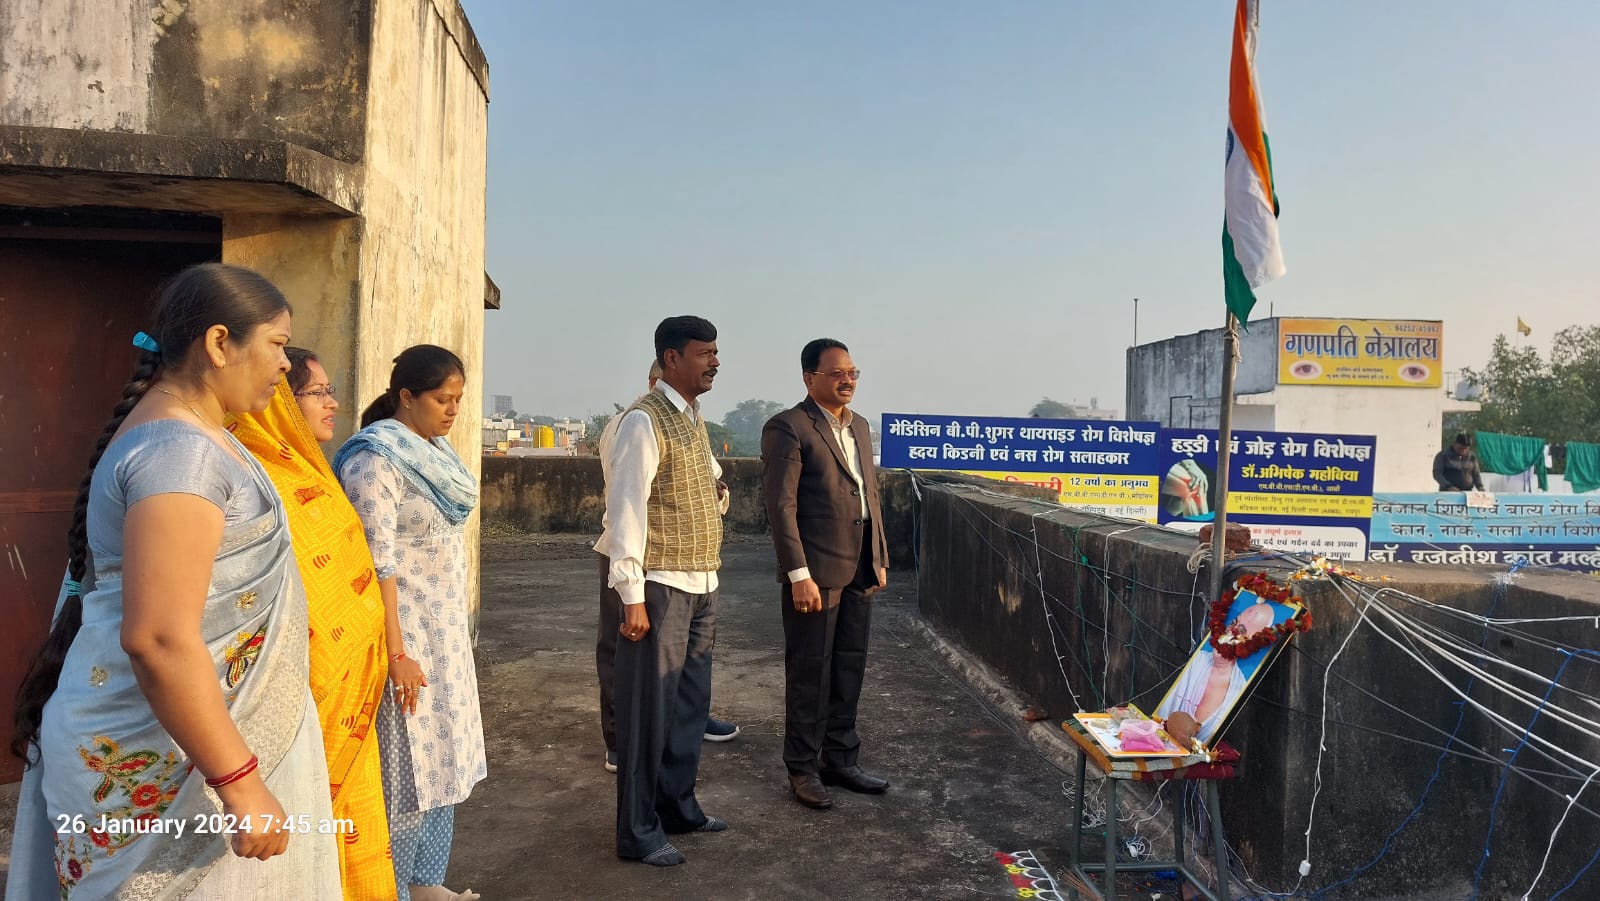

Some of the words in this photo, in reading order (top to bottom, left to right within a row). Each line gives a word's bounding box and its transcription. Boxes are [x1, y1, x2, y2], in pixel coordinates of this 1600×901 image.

[1285, 325, 1358, 357] गणपति
[1364, 327, 1439, 359] नेत्रालय
[889, 419, 941, 437] मेडिसिन
[1020, 426, 1076, 443] थायराइड
[1081, 424, 1104, 442] रोग
[1108, 426, 1156, 446] विशेषज्ञ
[943, 443, 985, 460] किडनी
[990, 445, 1010, 461] एवं
[1014, 449, 1037, 462] नस
[1042, 445, 1064, 462] रोग
[1069, 450, 1130, 464] सलाहकार
[1171, 434, 1209, 458] हड्डी
[1245, 436, 1276, 459] जोड़
[1281, 437, 1308, 457] रोग
[1313, 438, 1371, 462] विशेषज्ञ
[1070, 477, 1081, 486] 12
[1104, 479, 1116, 487] का
[1120, 479, 1149, 490] अनुभव
[1550, 500, 1577, 515] रोग
[1488, 525, 1521, 537] गला
[1528, 521, 1556, 537] रोग
[1324, 540, 1334, 548] का
[1502, 545, 1553, 566] कांत
